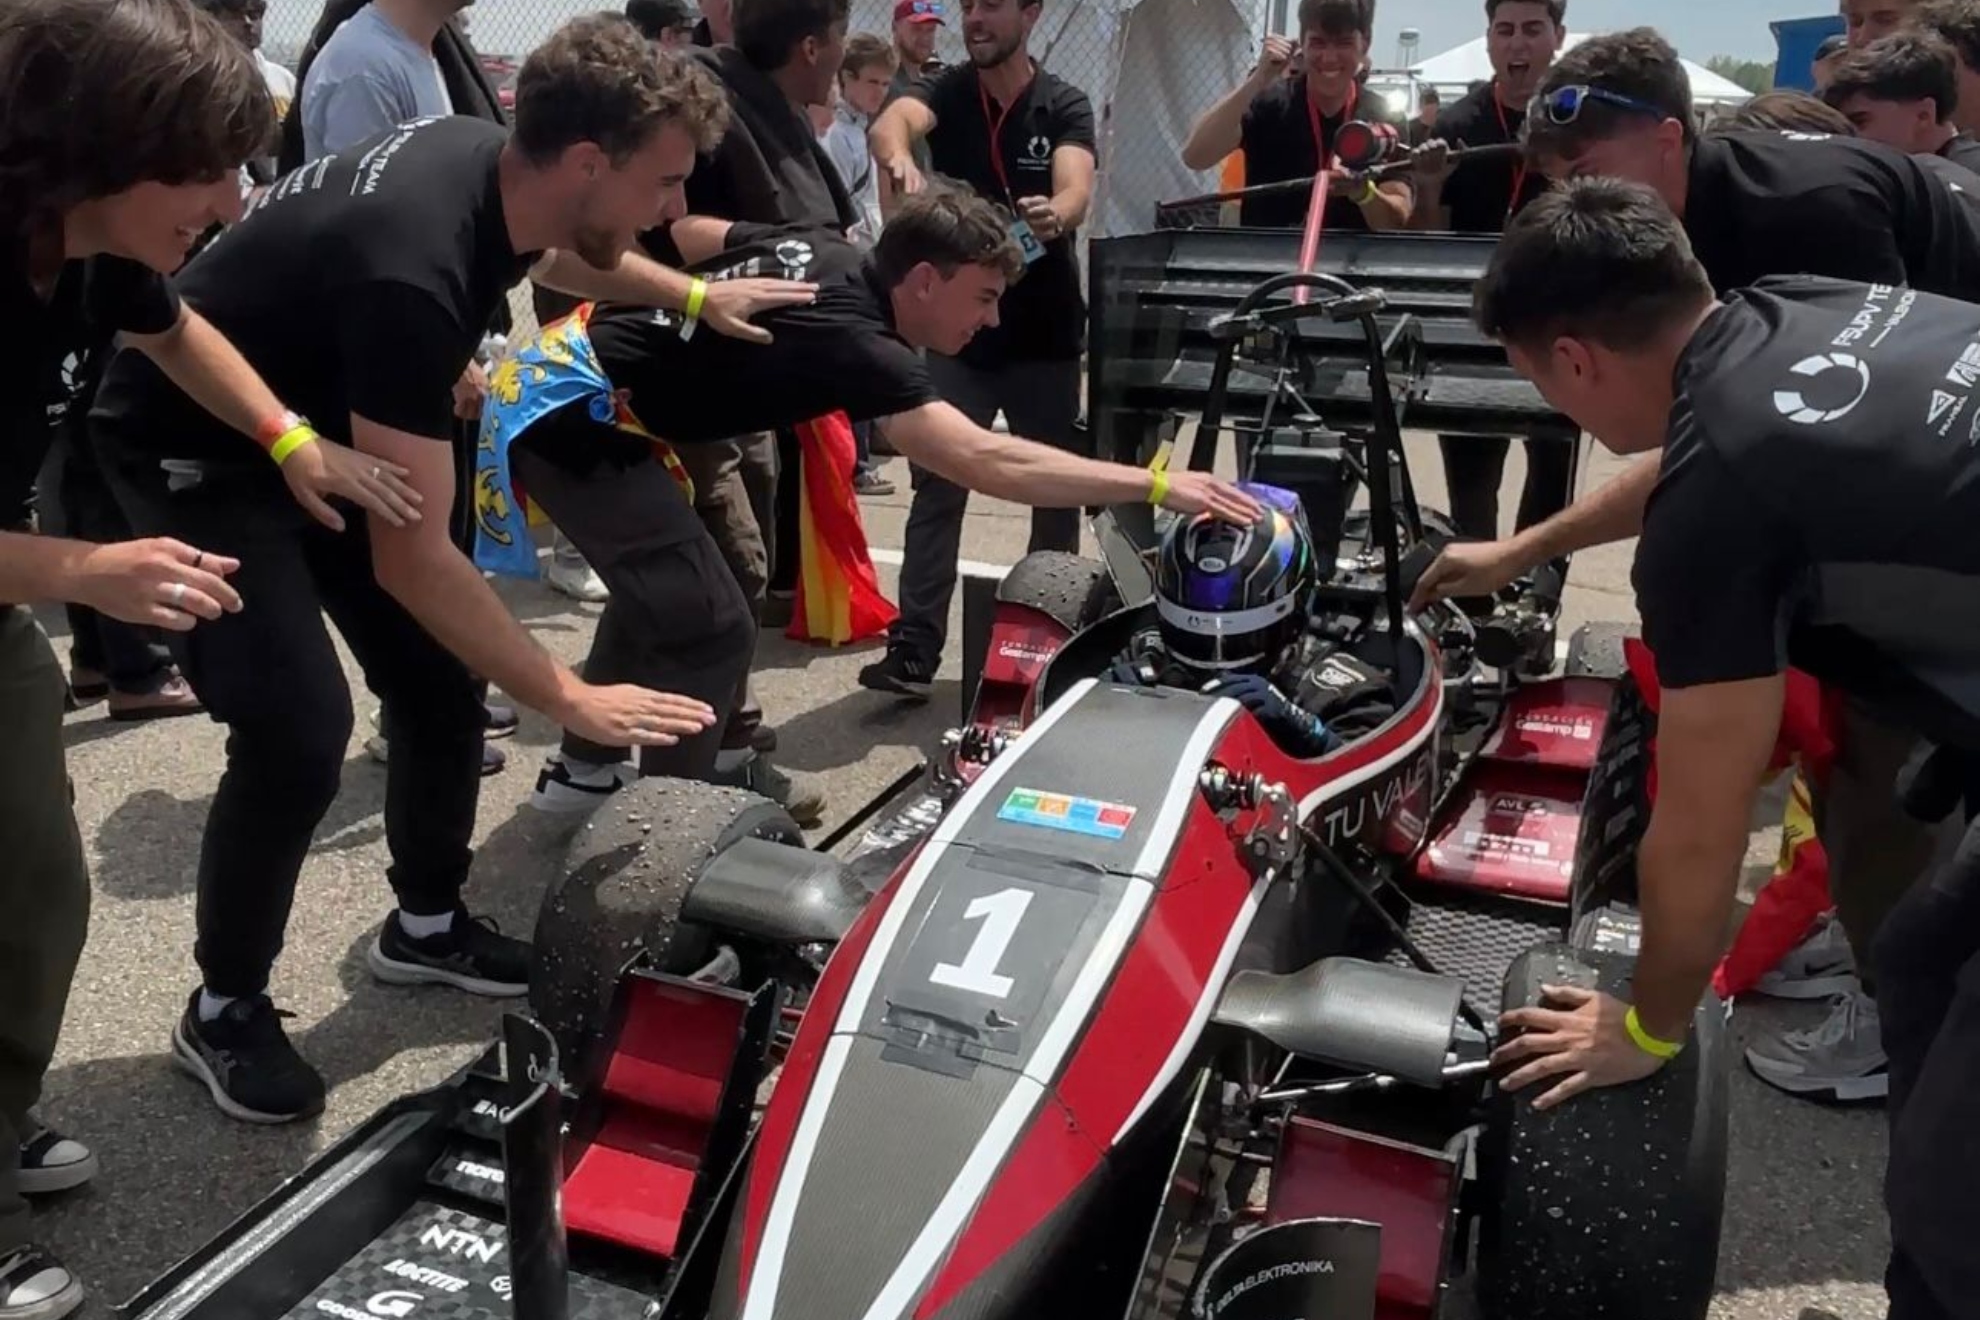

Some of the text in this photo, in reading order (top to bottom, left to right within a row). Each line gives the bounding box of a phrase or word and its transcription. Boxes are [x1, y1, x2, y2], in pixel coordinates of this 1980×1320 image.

[1831, 282, 1893, 346] FSUPV TE
[1325, 797, 1366, 848] TU
[1497, 799, 1524, 811] AVL
[928, 887, 1035, 999] 1
[420, 1224, 503, 1264] NTN
[382, 1258, 469, 1293] LOCTITE
